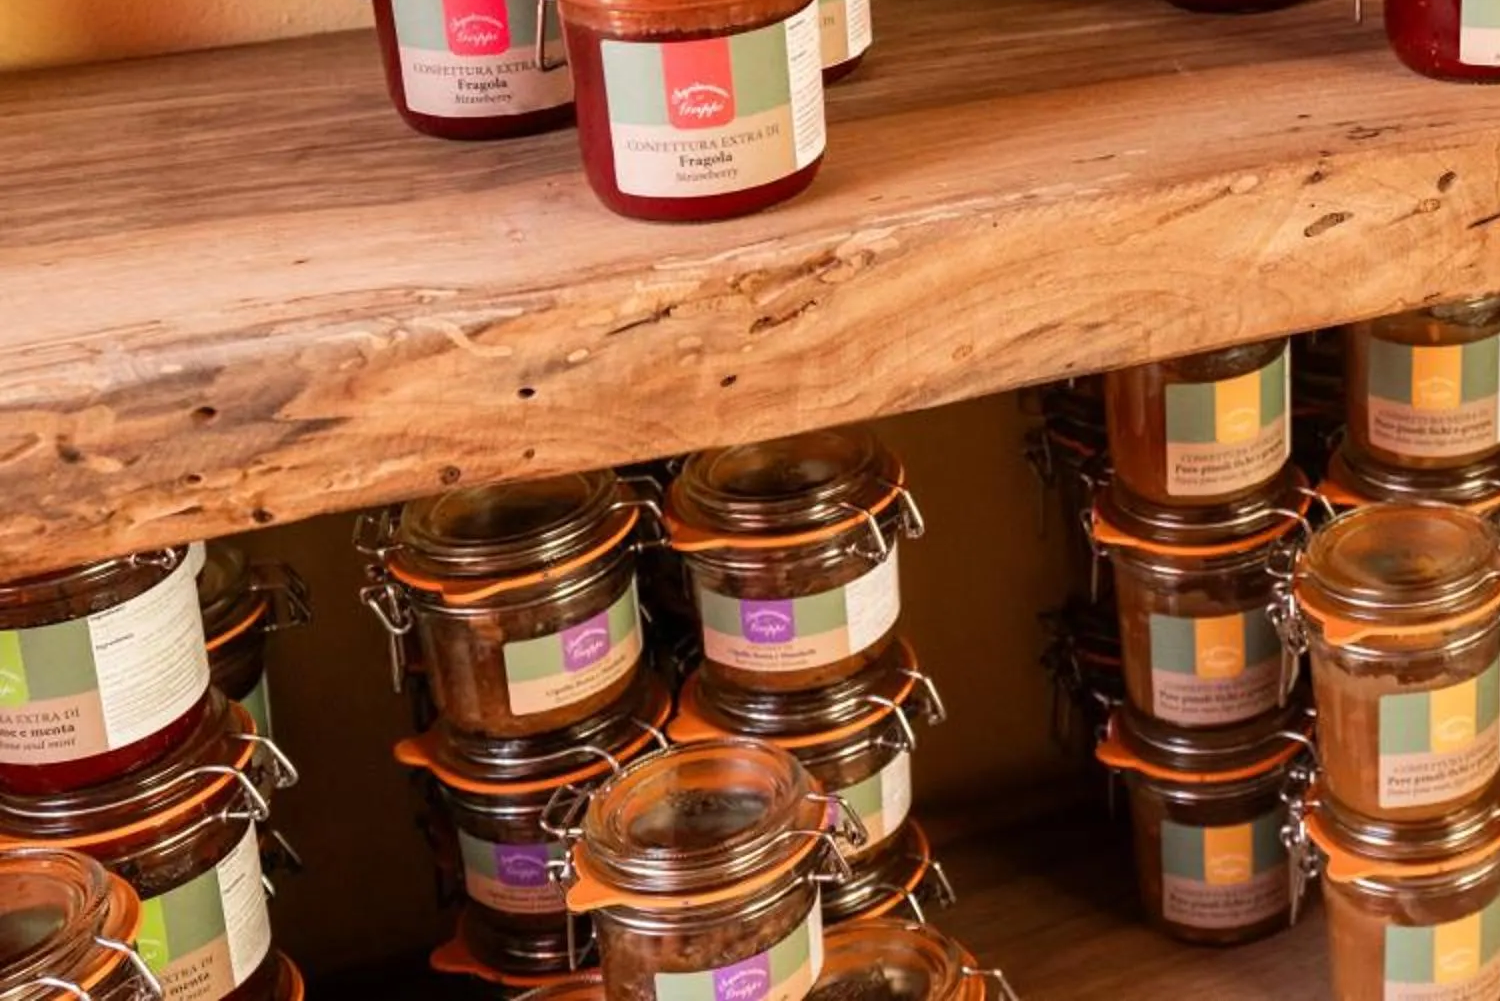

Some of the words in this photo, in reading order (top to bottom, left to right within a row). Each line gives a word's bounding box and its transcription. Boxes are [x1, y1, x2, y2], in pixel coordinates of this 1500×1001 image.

[457, 77, 509, 92] Fragola
[454, 92, 513, 105] Strawberry
[626, 137, 719, 153] CONFETTURA
[721, 129, 764, 150] EXTRA
[764, 123, 780, 139] DI
[678, 153, 734, 170] Fragola
[675, 166, 739, 184] Strawberry
[30, 724, 75, 737] menta
